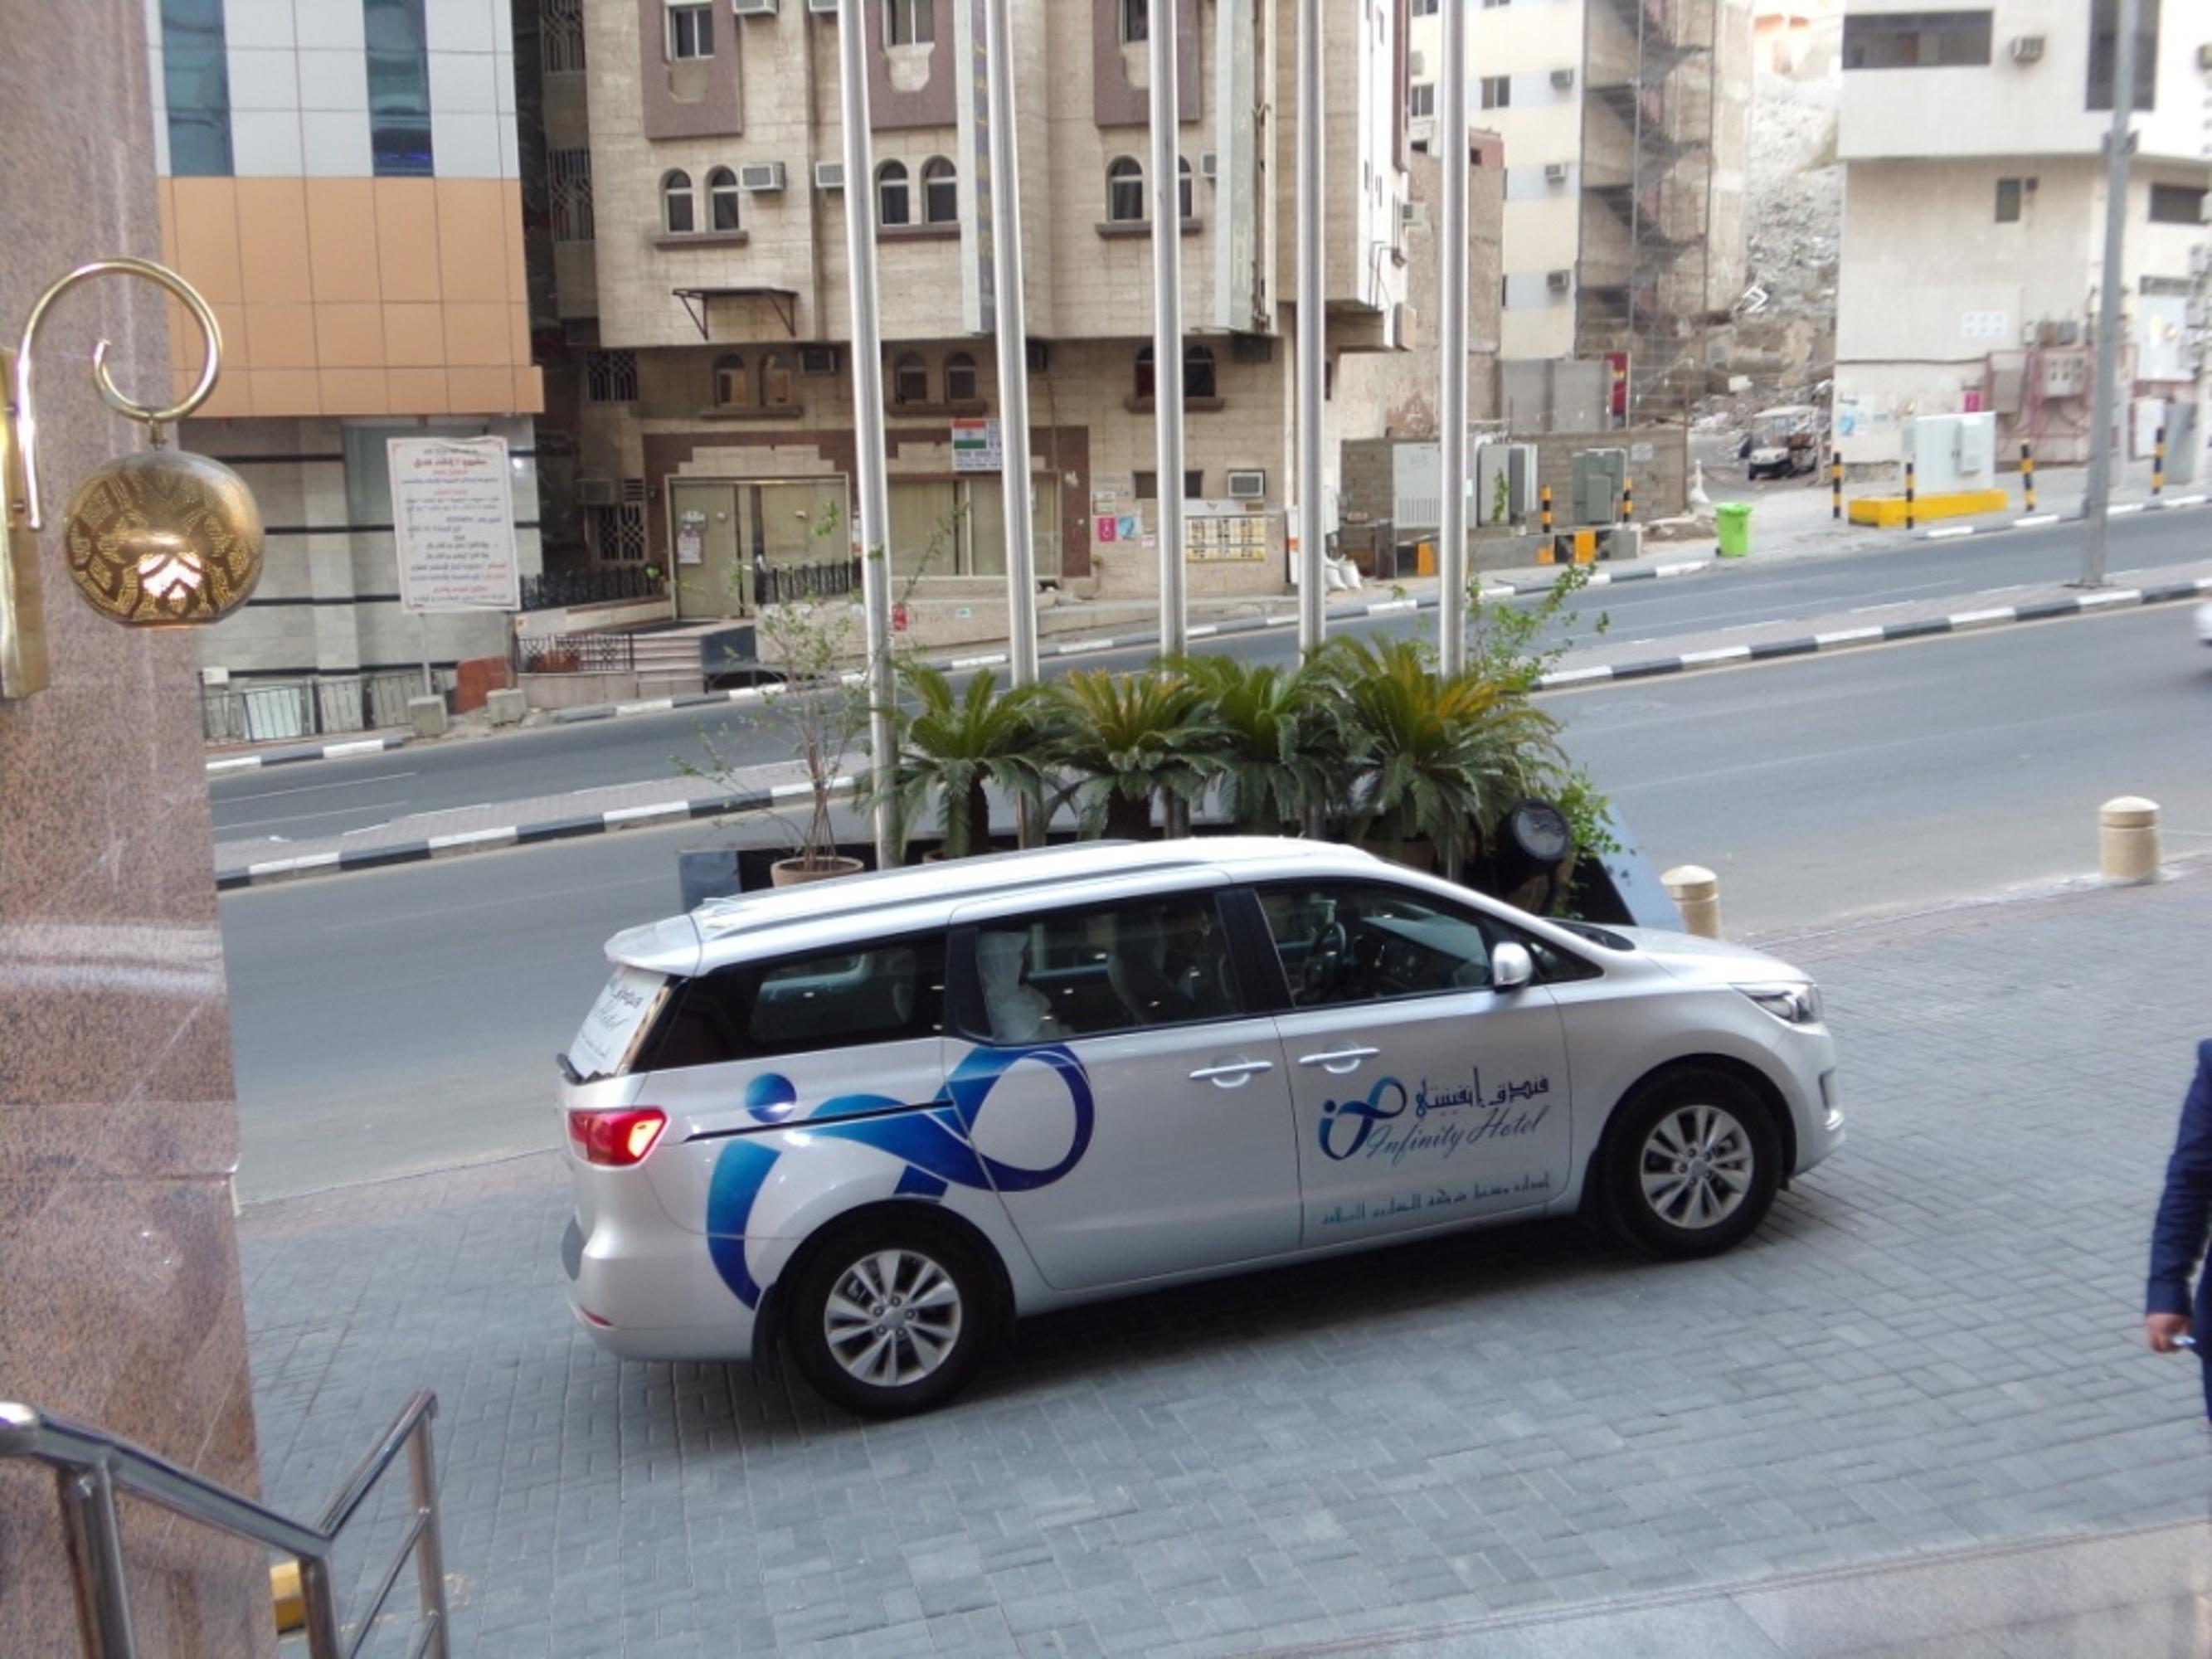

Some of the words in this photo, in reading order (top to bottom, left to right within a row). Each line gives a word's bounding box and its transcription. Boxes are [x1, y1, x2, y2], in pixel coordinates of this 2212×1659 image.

[1488, 1075, 1549, 1106] فندق
[1364, 1121, 1466, 1166] Infinity
[1466, 1105, 1551, 1145] Hotel
